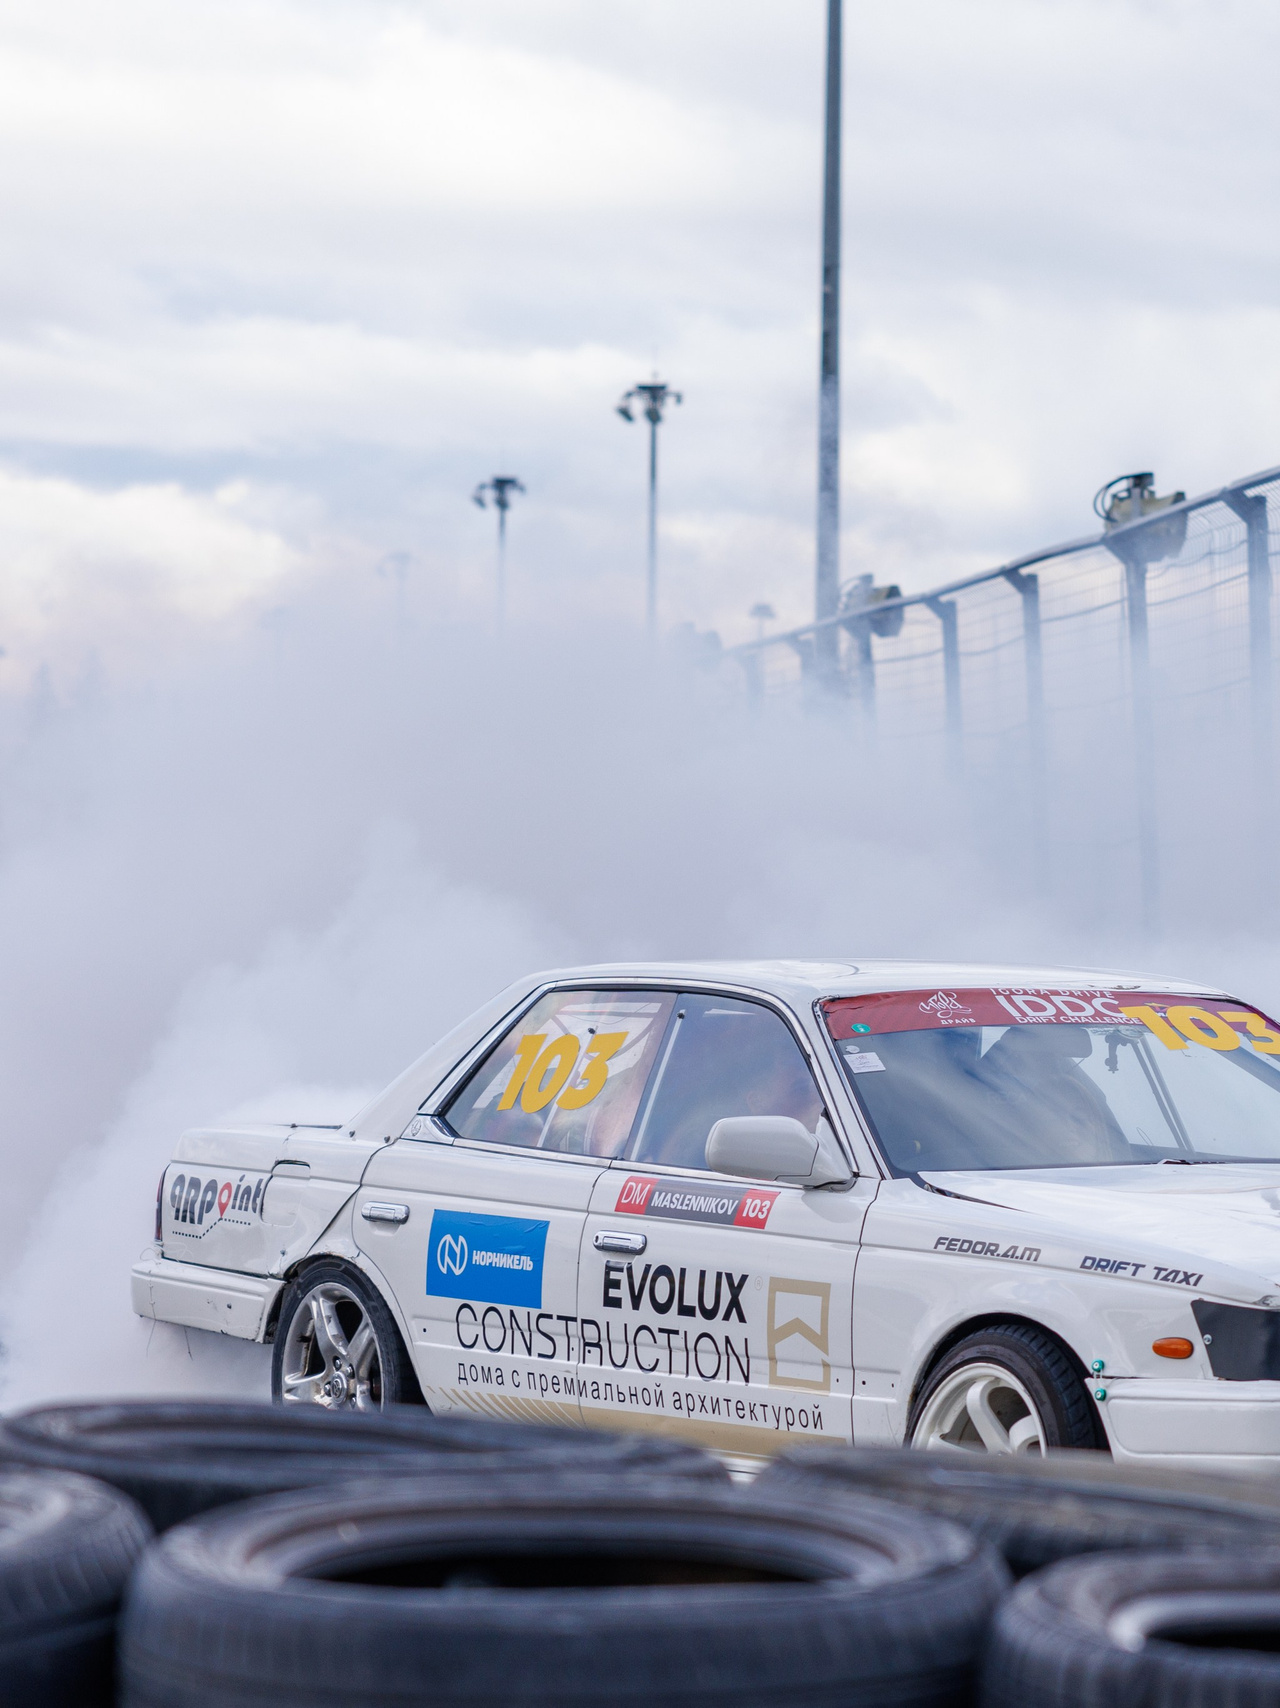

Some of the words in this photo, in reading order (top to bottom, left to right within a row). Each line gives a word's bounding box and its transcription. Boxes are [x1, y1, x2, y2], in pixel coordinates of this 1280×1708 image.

[995, 995, 1125, 1017] IDDC
[1015, 1016, 1058, 1024] DRIFT
[1060, 1016, 1143, 1025] CHALLENGE
[497, 1031, 629, 1113] 103
[621, 1182, 651, 1206] DM
[651, 1191, 739, 1215] MASLENNIKOV
[742, 1198, 771, 1219] 103
[472, 1250, 534, 1271] НОРНИКЕЛЬ
[1080, 1256, 1146, 1277] DRIFT
[1153, 1266, 1204, 1287] TAXI
[603, 1260, 749, 1323] EVOLUX
[456, 1303, 750, 1386] CONSTRUCTION
[458, 1362, 505, 1386] дома
[511, 1369, 521, 1388] с
[527, 1371, 665, 1409] премиальной
[672, 1390, 824, 1431] архитектурой
